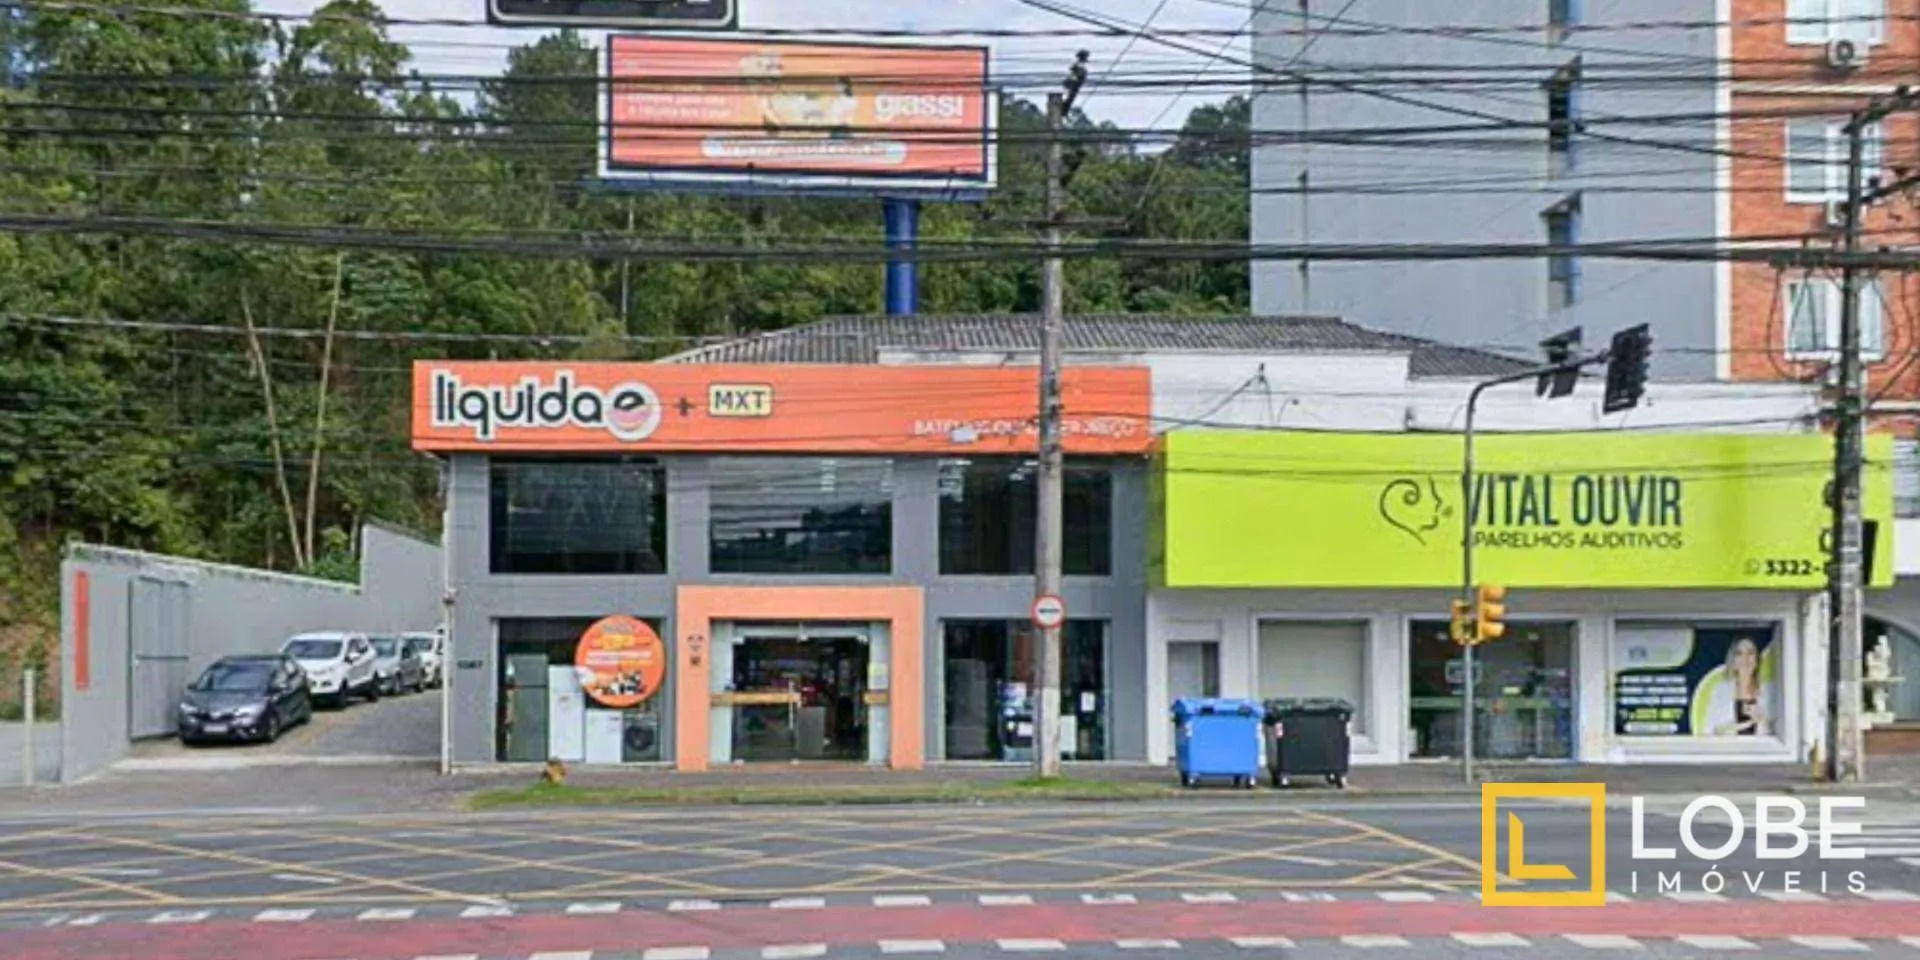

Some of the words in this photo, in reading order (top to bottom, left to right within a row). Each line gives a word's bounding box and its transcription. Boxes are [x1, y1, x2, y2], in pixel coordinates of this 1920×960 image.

[713, 390, 768, 411] MXT
[1461, 473, 1560, 526] VITAL
[1572, 473, 1682, 527] OUVIR
[1579, 531, 1683, 549] AUDITIVOS
